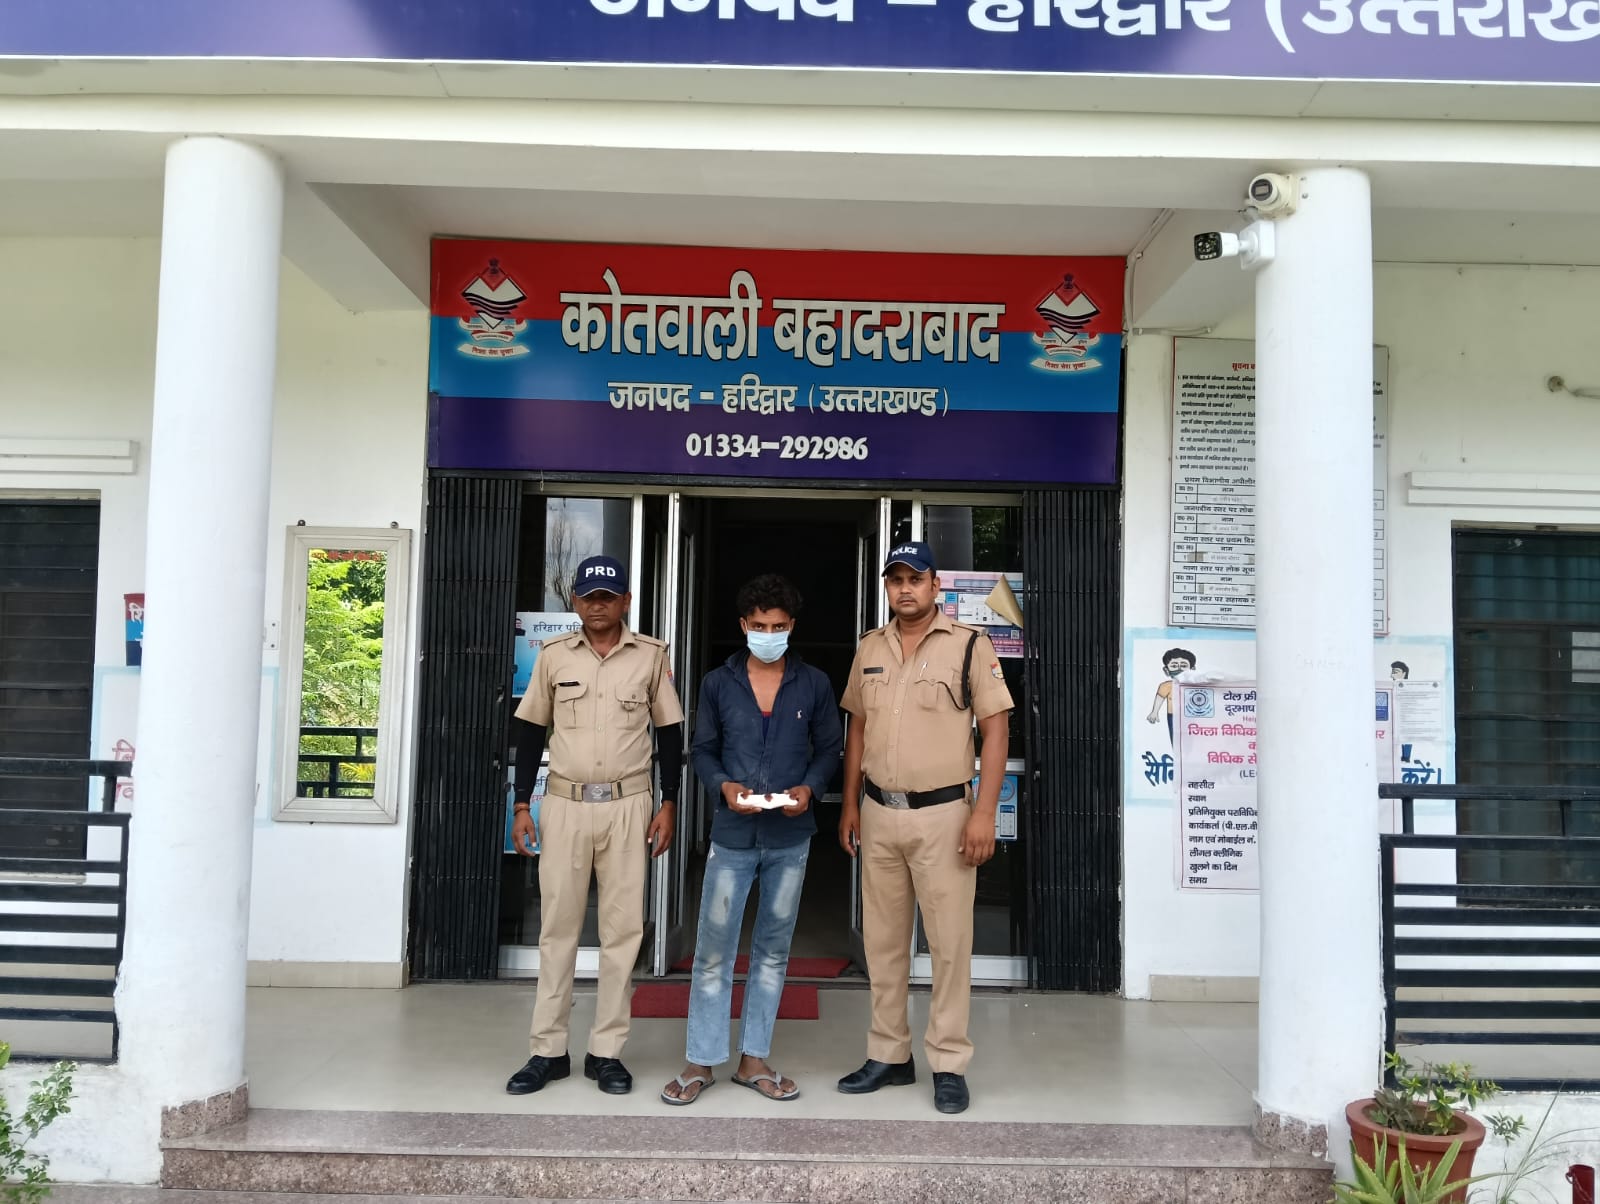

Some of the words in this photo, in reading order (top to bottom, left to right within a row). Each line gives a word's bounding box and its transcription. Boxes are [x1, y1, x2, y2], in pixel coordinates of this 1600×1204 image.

[560, 268, 762, 361] कोतवाली
[772, 298, 1006, 367] बहादराबाद
[607, 381, 693, 412] जनपद
[722, 373, 798, 416] हरिद्वार
[891, 545, 918, 557] POLICE
[585, 565, 616, 578] PRD
[533, 621, 563, 633] हरिद्वार
[1223, 690, 1241, 702] टोल
[1188, 723, 1219, 737] जिला
[1208, 751, 1245, 764] विधिक
[1239, 769, 1257, 779] (LE
[1187, 779, 1215, 790] तहसील
[1188, 835, 1203, 844] नाम
[1189, 847, 1212, 857] लीगल
[1189, 861, 1210, 873] खुलने
[1211, 863, 1222, 871] का
[1223, 861, 1238, 871] दिन
[1188, 876, 1208, 884] समय
